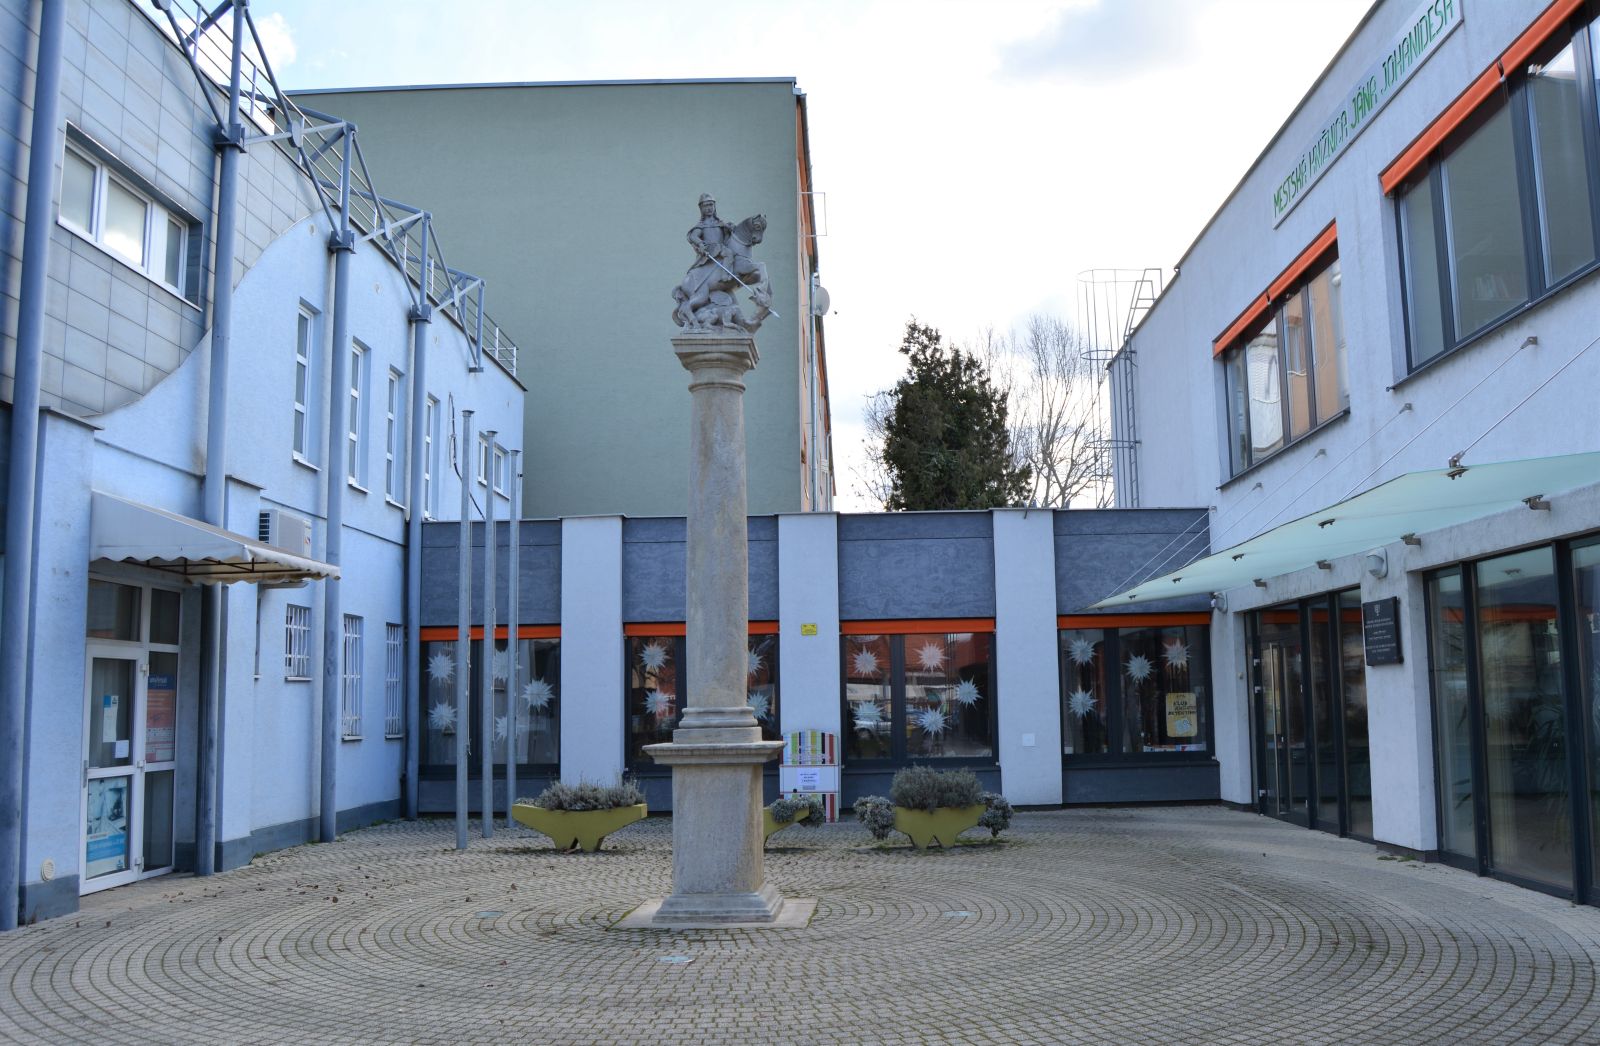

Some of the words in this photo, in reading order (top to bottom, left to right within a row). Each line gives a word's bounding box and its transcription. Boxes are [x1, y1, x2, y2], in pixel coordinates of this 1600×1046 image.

[1273, 154, 1307, 218] MESTSKÁ
[1309, 110, 1348, 178] KNIŽNICA
[1350, 75, 1378, 129] JÁNA
